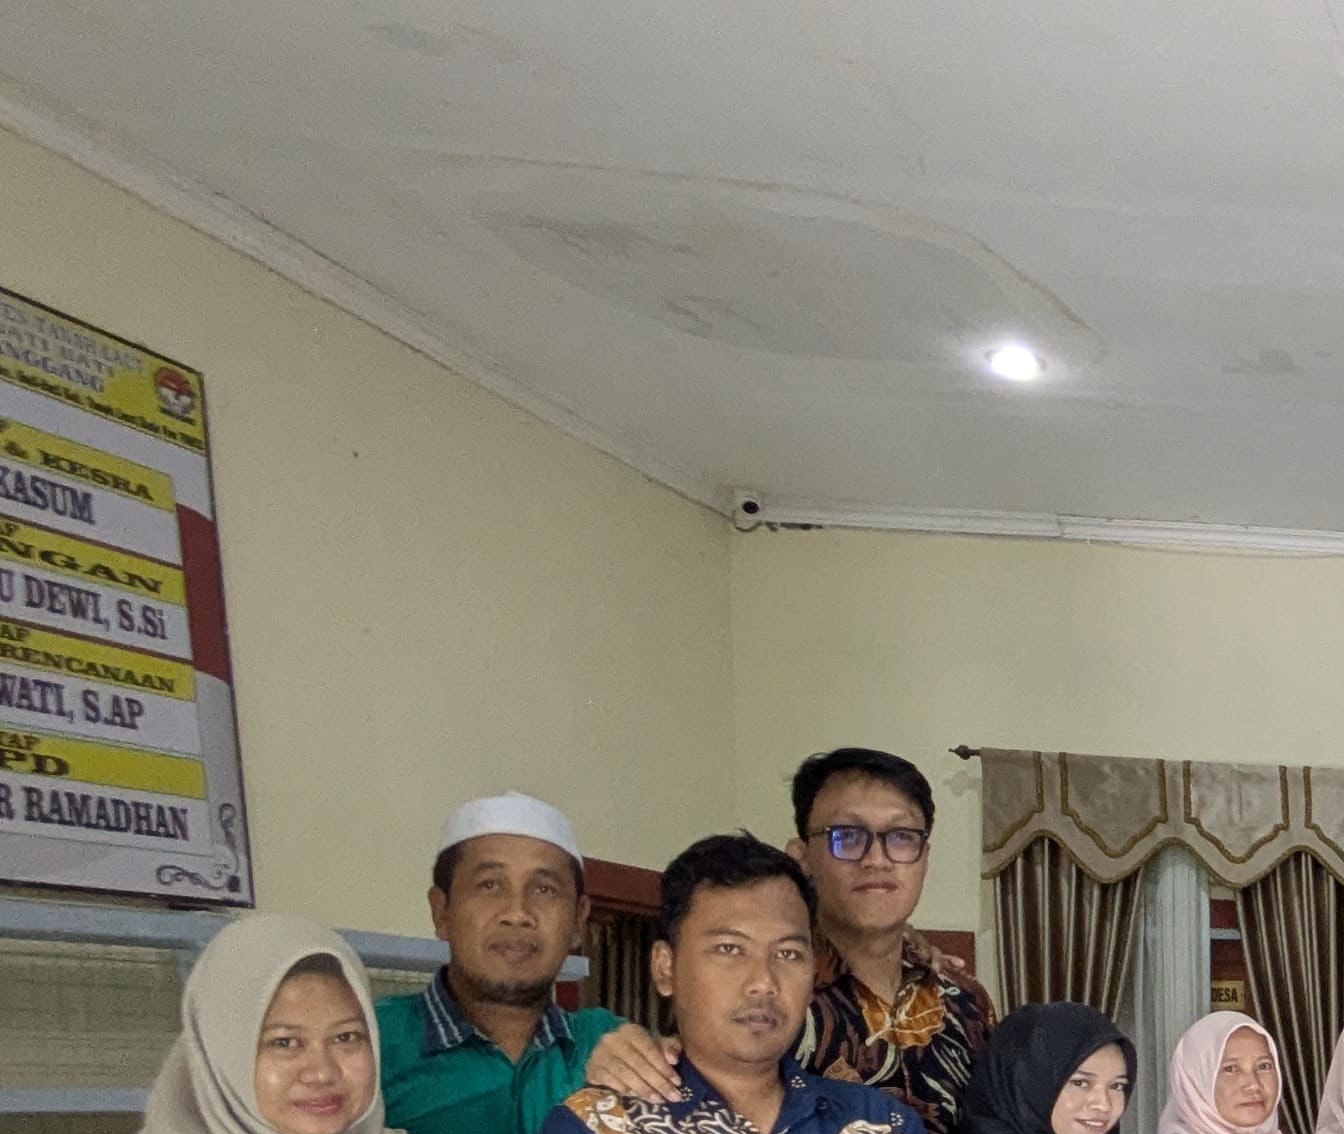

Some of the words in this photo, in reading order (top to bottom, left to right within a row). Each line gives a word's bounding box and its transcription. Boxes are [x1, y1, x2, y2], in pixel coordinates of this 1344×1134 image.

[38, 449, 155, 501] KESRA
[24, 574, 110, 632] DEWI,
[117, 598, 168, 640] S.Si
[82, 688, 144, 730] S.AP
[22, 785, 190, 842] RAMADHAN
